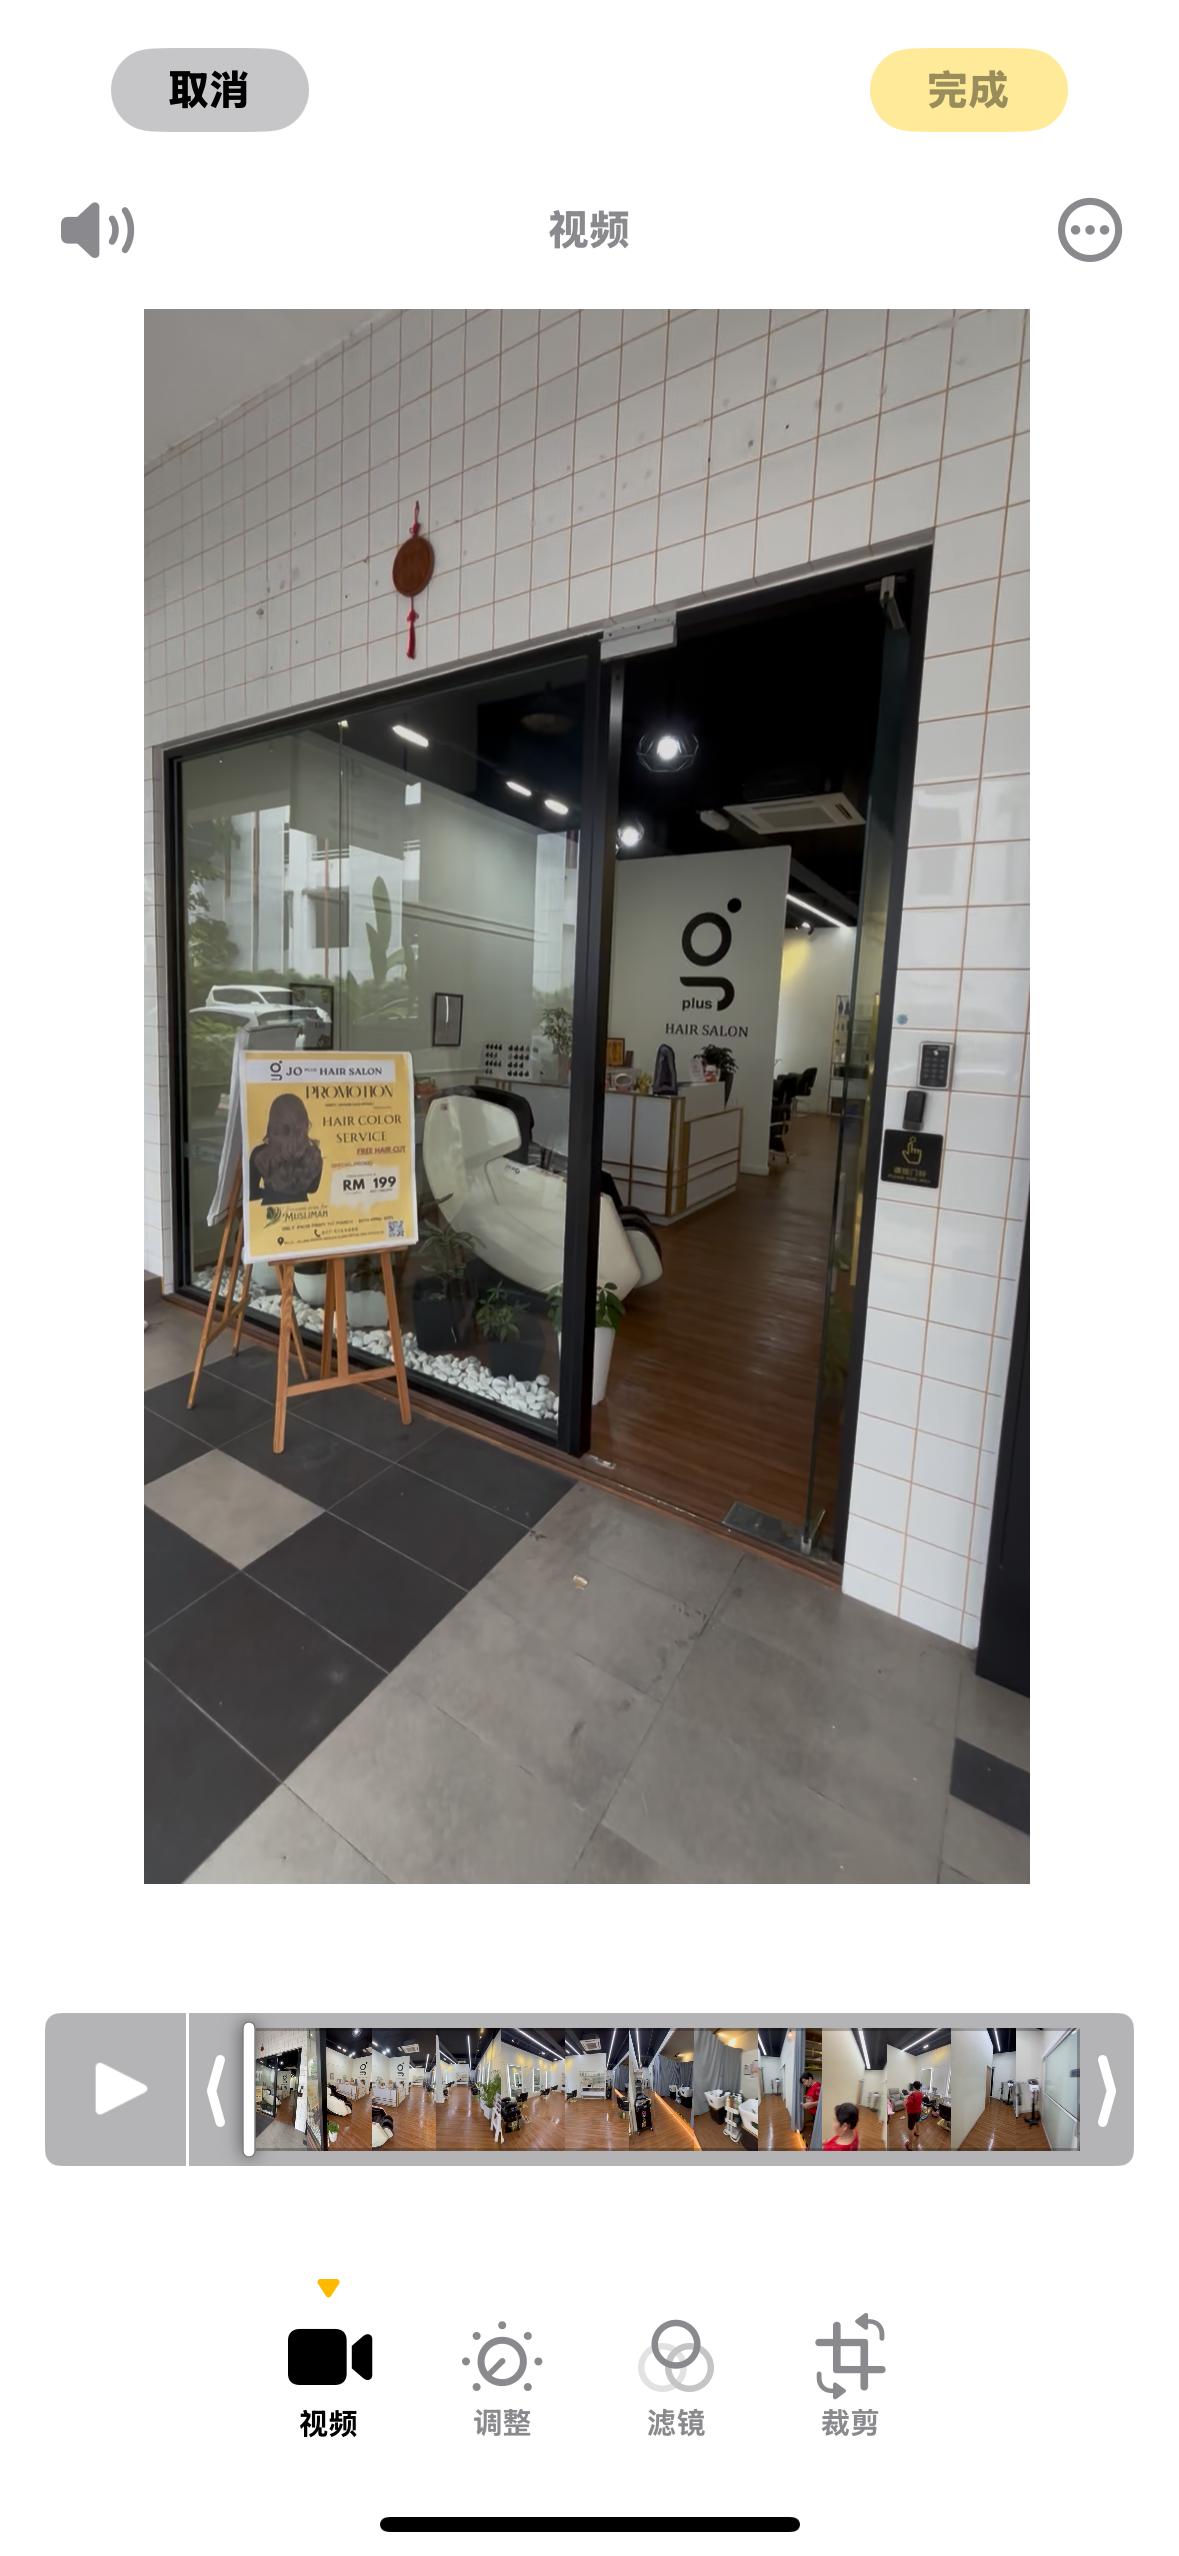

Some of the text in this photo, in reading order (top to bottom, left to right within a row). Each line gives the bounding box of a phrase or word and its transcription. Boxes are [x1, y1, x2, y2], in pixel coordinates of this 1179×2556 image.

[682, 997, 713, 1012] plus
[665, 1023, 749, 1038] HAIR SALON
[286, 1066, 303, 1077] JO
[319, 1067, 346, 1077] HAIR
[348, 1066, 383, 1077] SALON
[305, 1084, 393, 1100] PROMOTION
[322, 1114, 402, 1127] HAIR COLOR
[336, 1131, 387, 1143] SERVICE
[356, 1147, 373, 1156] FREE
[342, 1178, 366, 1191] RM
[373, 1175, 397, 1189] 199
